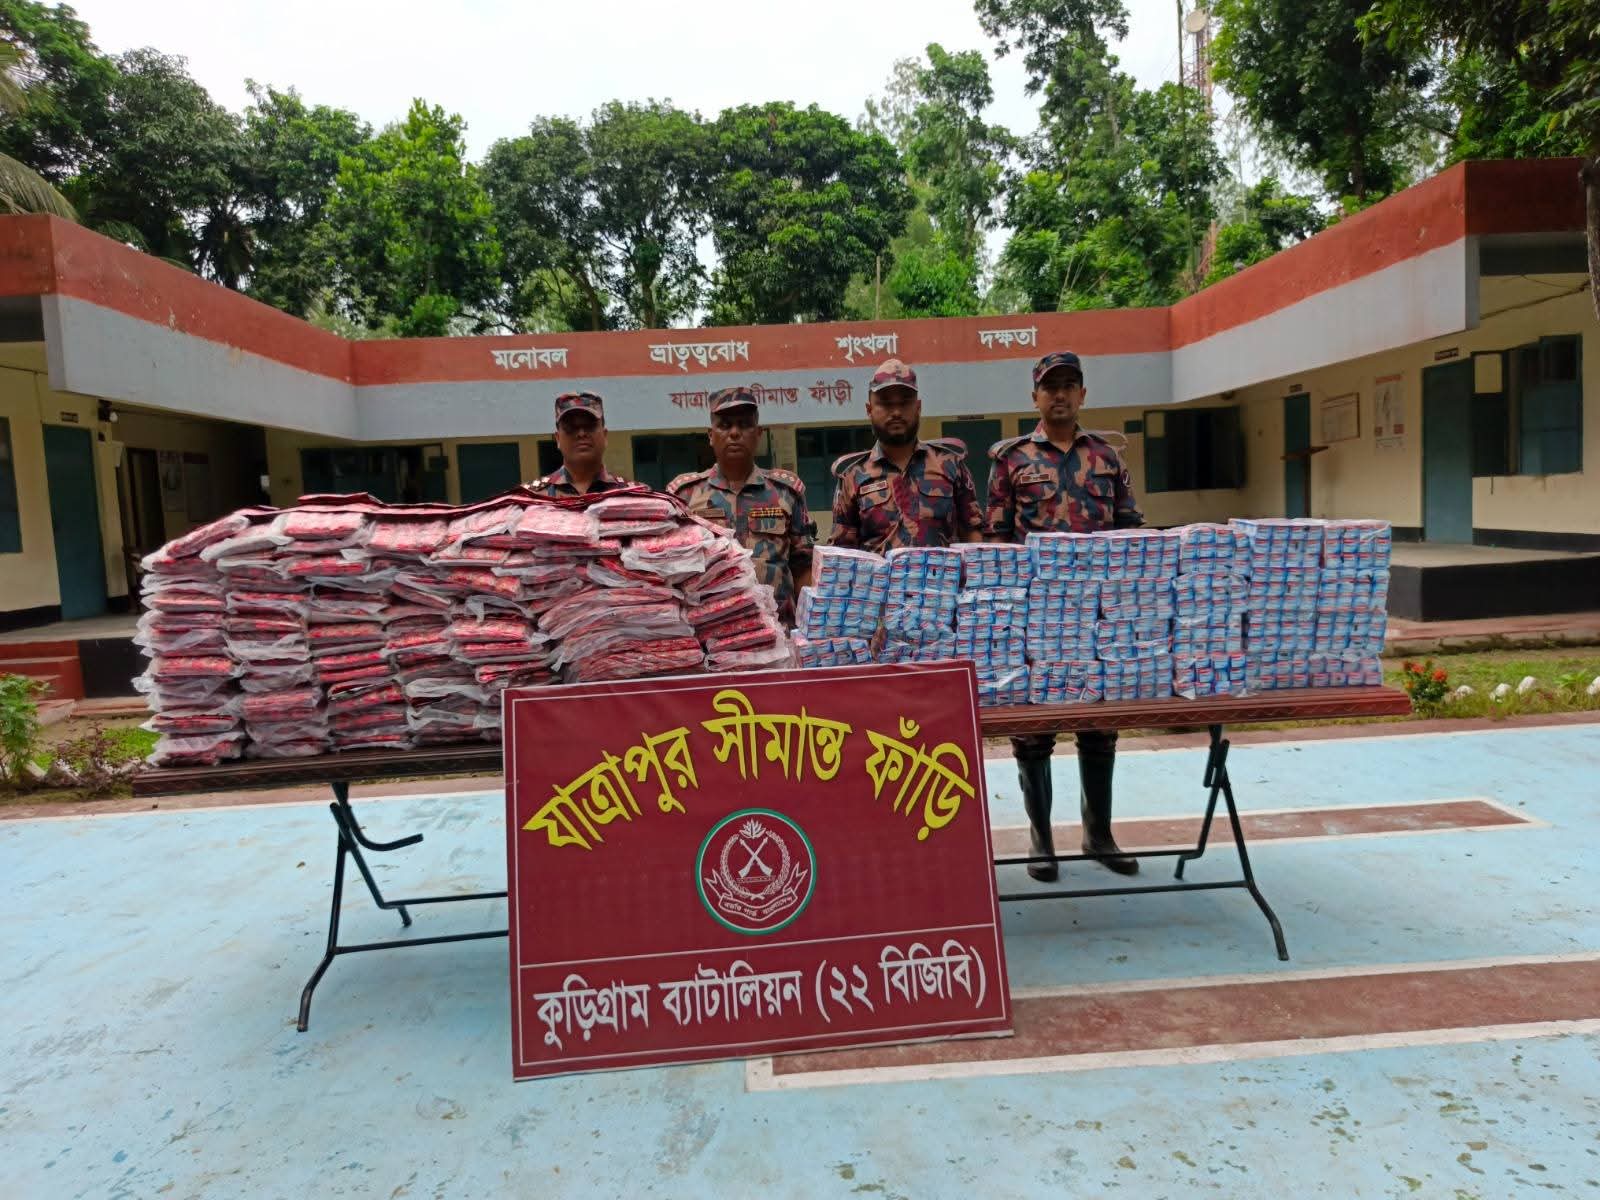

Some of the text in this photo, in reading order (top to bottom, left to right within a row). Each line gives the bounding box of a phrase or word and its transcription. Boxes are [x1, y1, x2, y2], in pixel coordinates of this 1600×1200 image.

[490, 326, 1038, 371] মনোবল ভ্রাতৃত্ববোধ শৃংখলা দক্ষতা
[669, 388, 711, 409] যাত্রা
[522, 689, 975, 850] যাত্রাপুর সীমান্ত ফাঁড়ি
[533, 939, 987, 1050] কুড়িগ্রাম ব্যাটালিয়ন (২২ বিজিবি)
